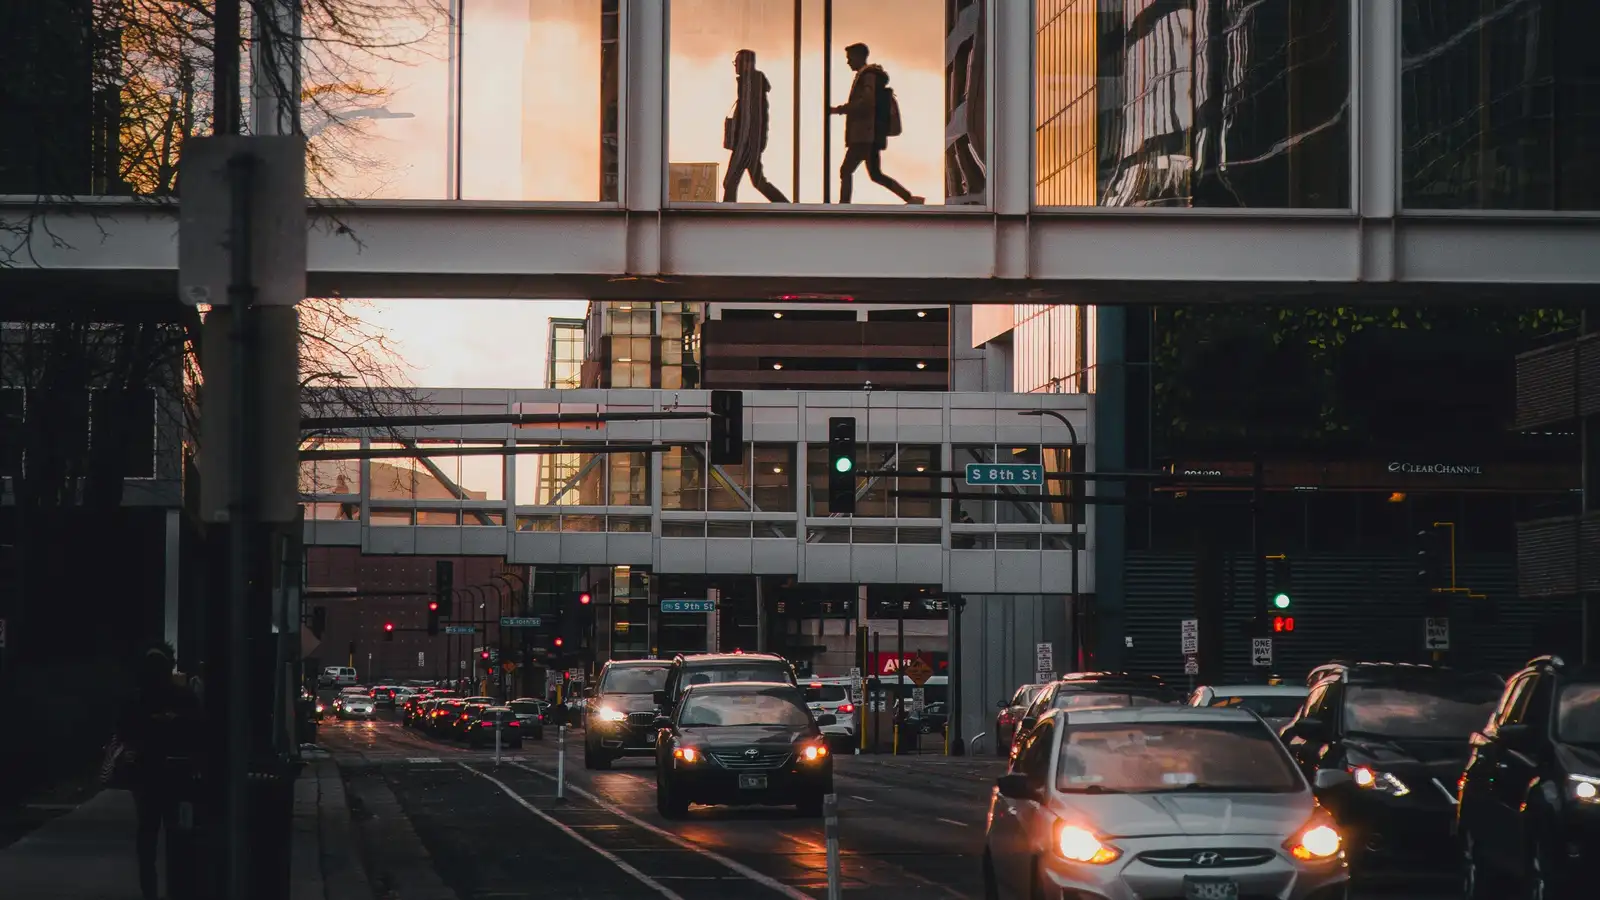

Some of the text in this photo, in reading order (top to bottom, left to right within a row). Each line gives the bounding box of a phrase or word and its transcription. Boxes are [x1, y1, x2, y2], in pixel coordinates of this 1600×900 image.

[972, 469, 1037, 480] S 8th St
[674, 602, 714, 610] S 9th St
[1254, 647, 1270, 655] WAY
